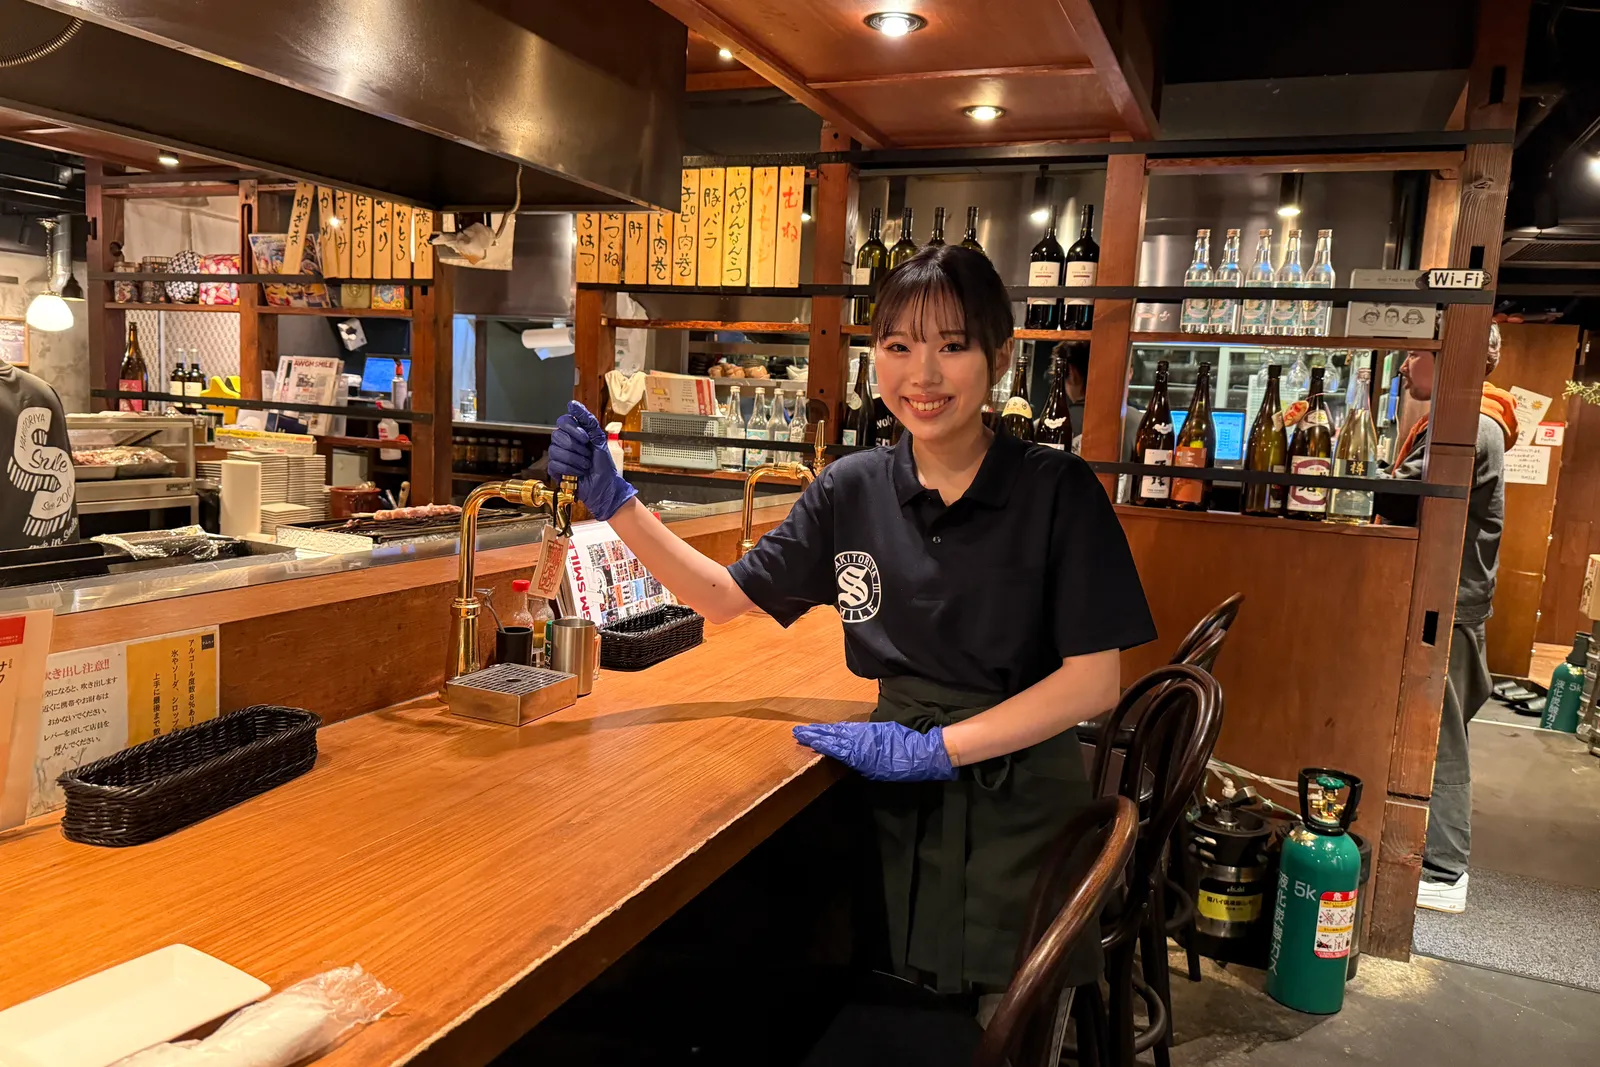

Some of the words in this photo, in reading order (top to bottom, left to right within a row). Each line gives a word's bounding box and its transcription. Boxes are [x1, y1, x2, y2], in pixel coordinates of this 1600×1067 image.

[628, 220, 643, 246] 肝
[703, 187, 721, 249] 豚バラ
[726, 182, 748, 282] やげんなんこつ
[782, 186, 801, 243] むね
[651, 213, 668, 280] ト肉巻
[1434, 272, 1480, 287] Wi-Fi
[188, 639, 196, 726] アルコール度数8%あり
[1294, 880, 1317, 901] 5k
[1269, 871, 1289, 976] 液化炭酸ガス
